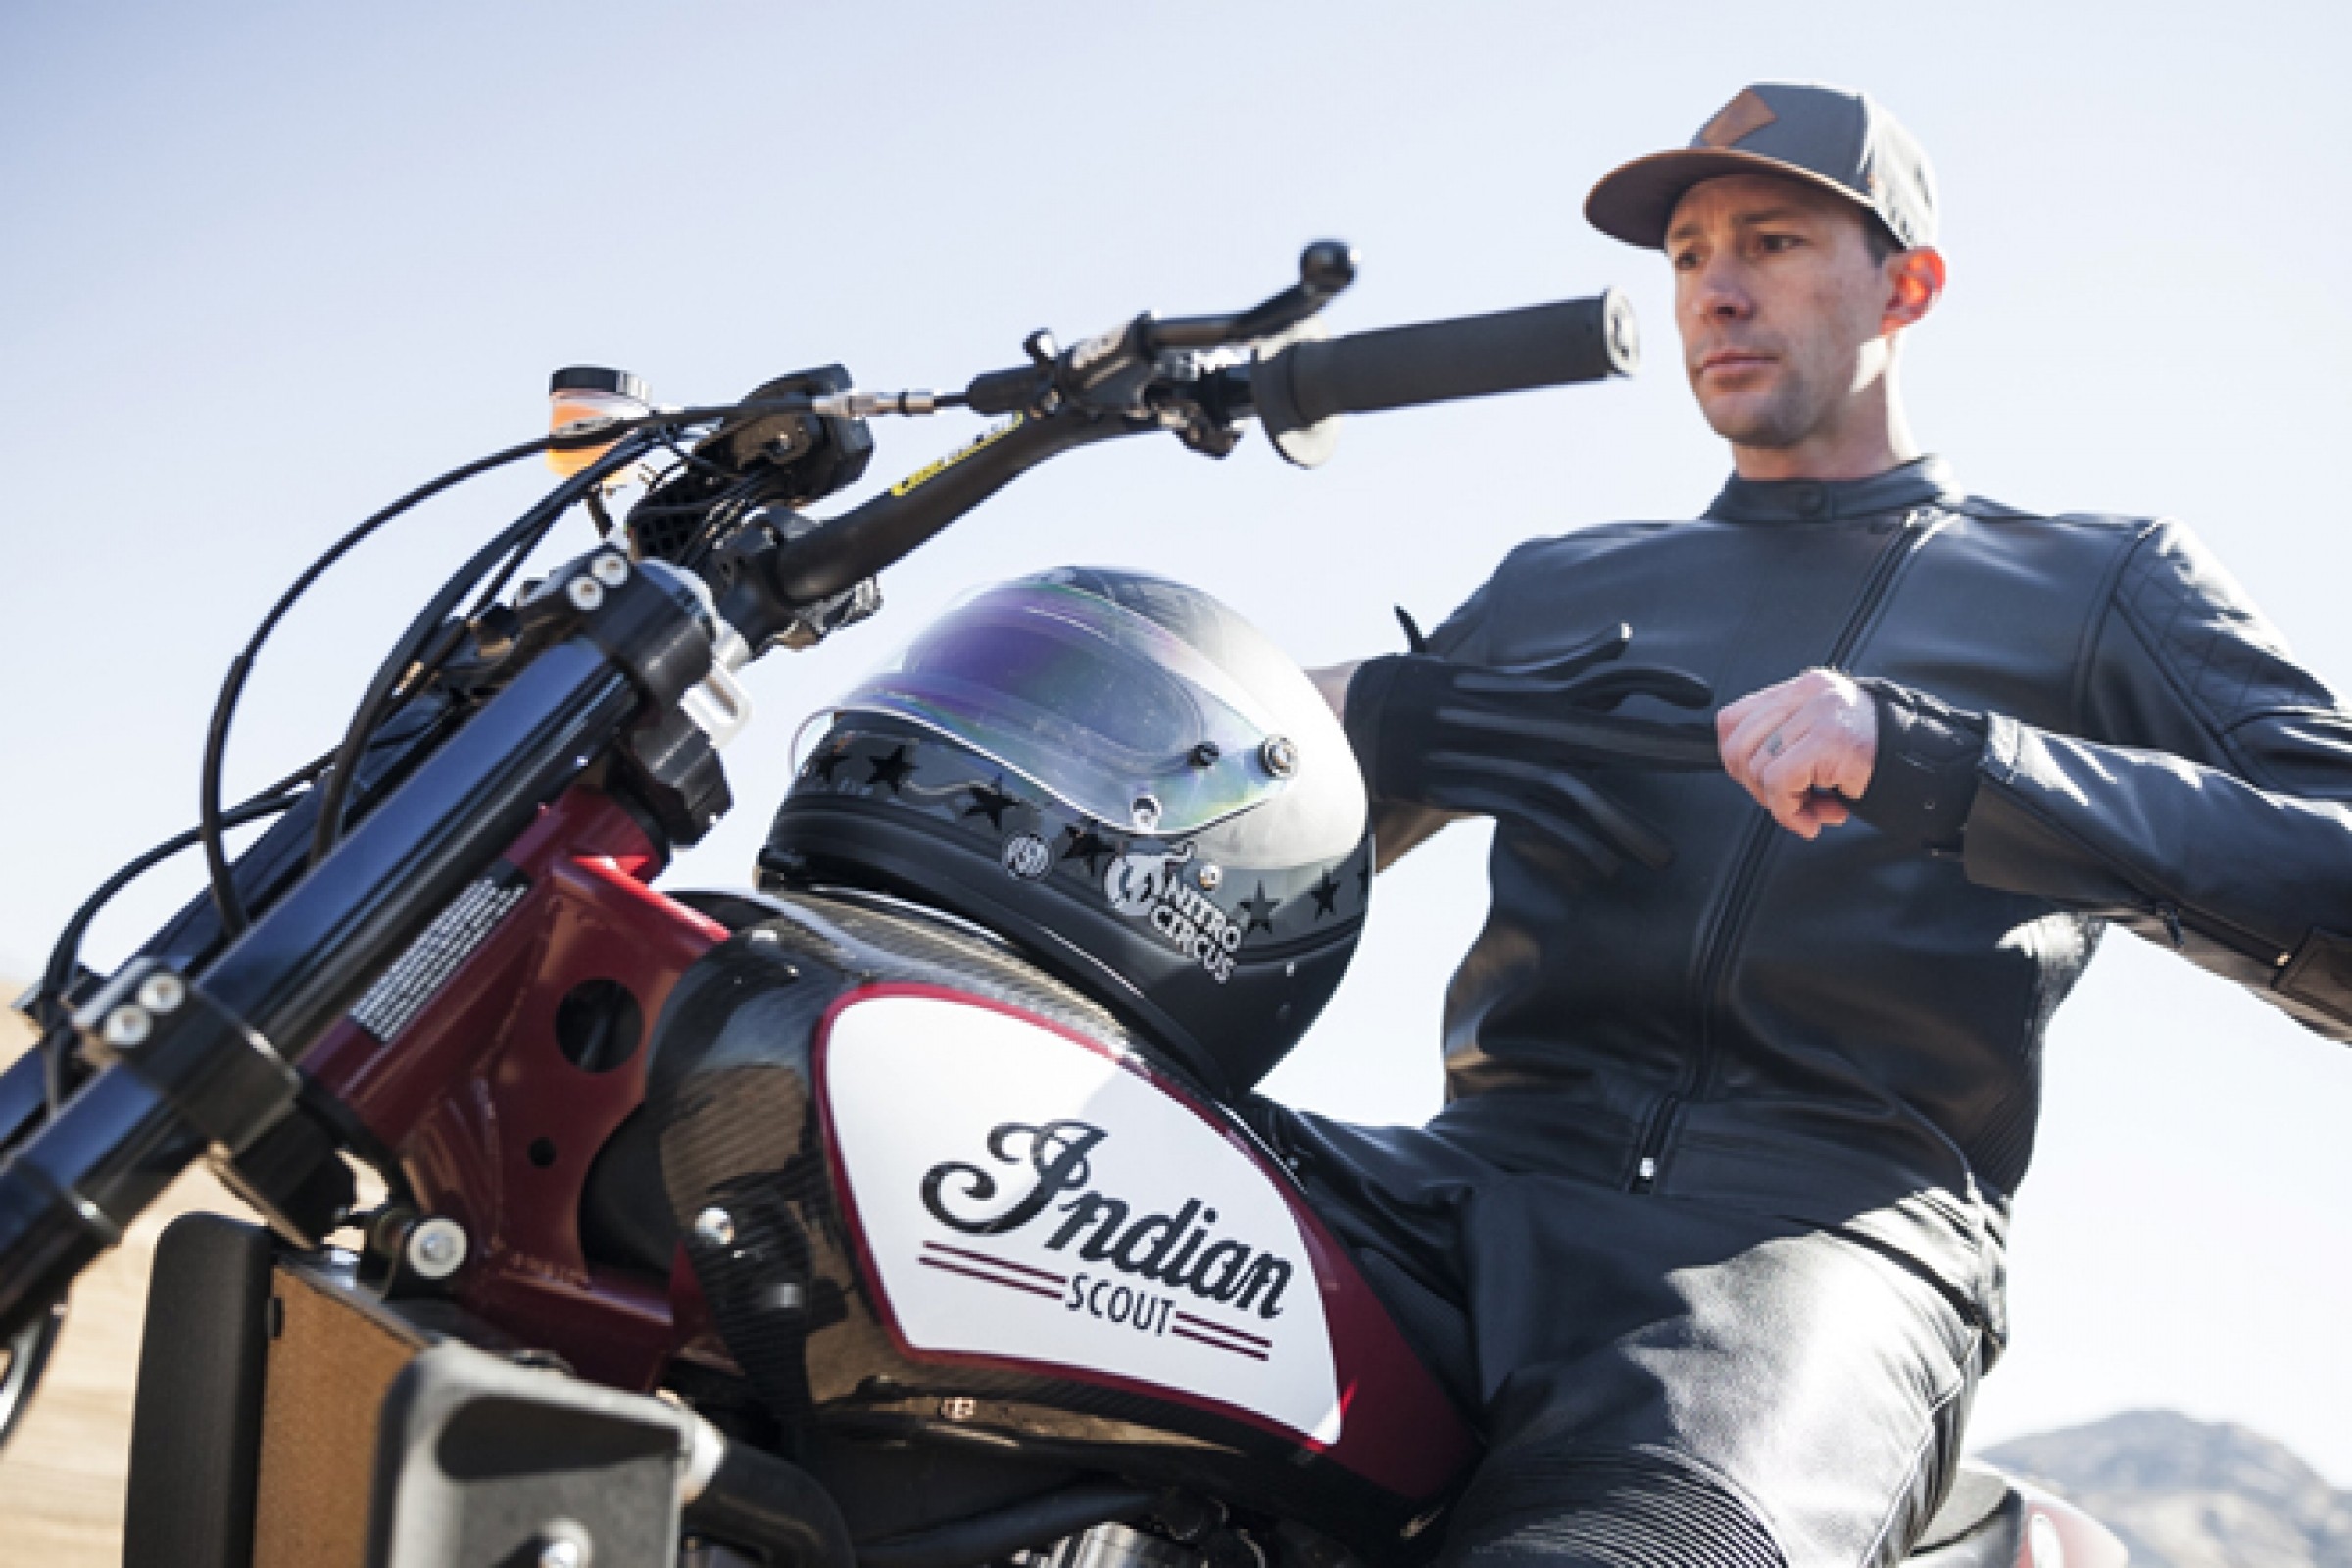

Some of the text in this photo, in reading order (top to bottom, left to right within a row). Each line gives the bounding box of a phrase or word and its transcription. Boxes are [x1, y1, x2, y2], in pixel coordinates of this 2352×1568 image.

[1152, 904, 1238, 984] CIRCUS
[1165, 875, 1241, 952] NITRO
[920, 1119, 1293, 1318] Indian
[1065, 1271, 1176, 1335] SCOUT
